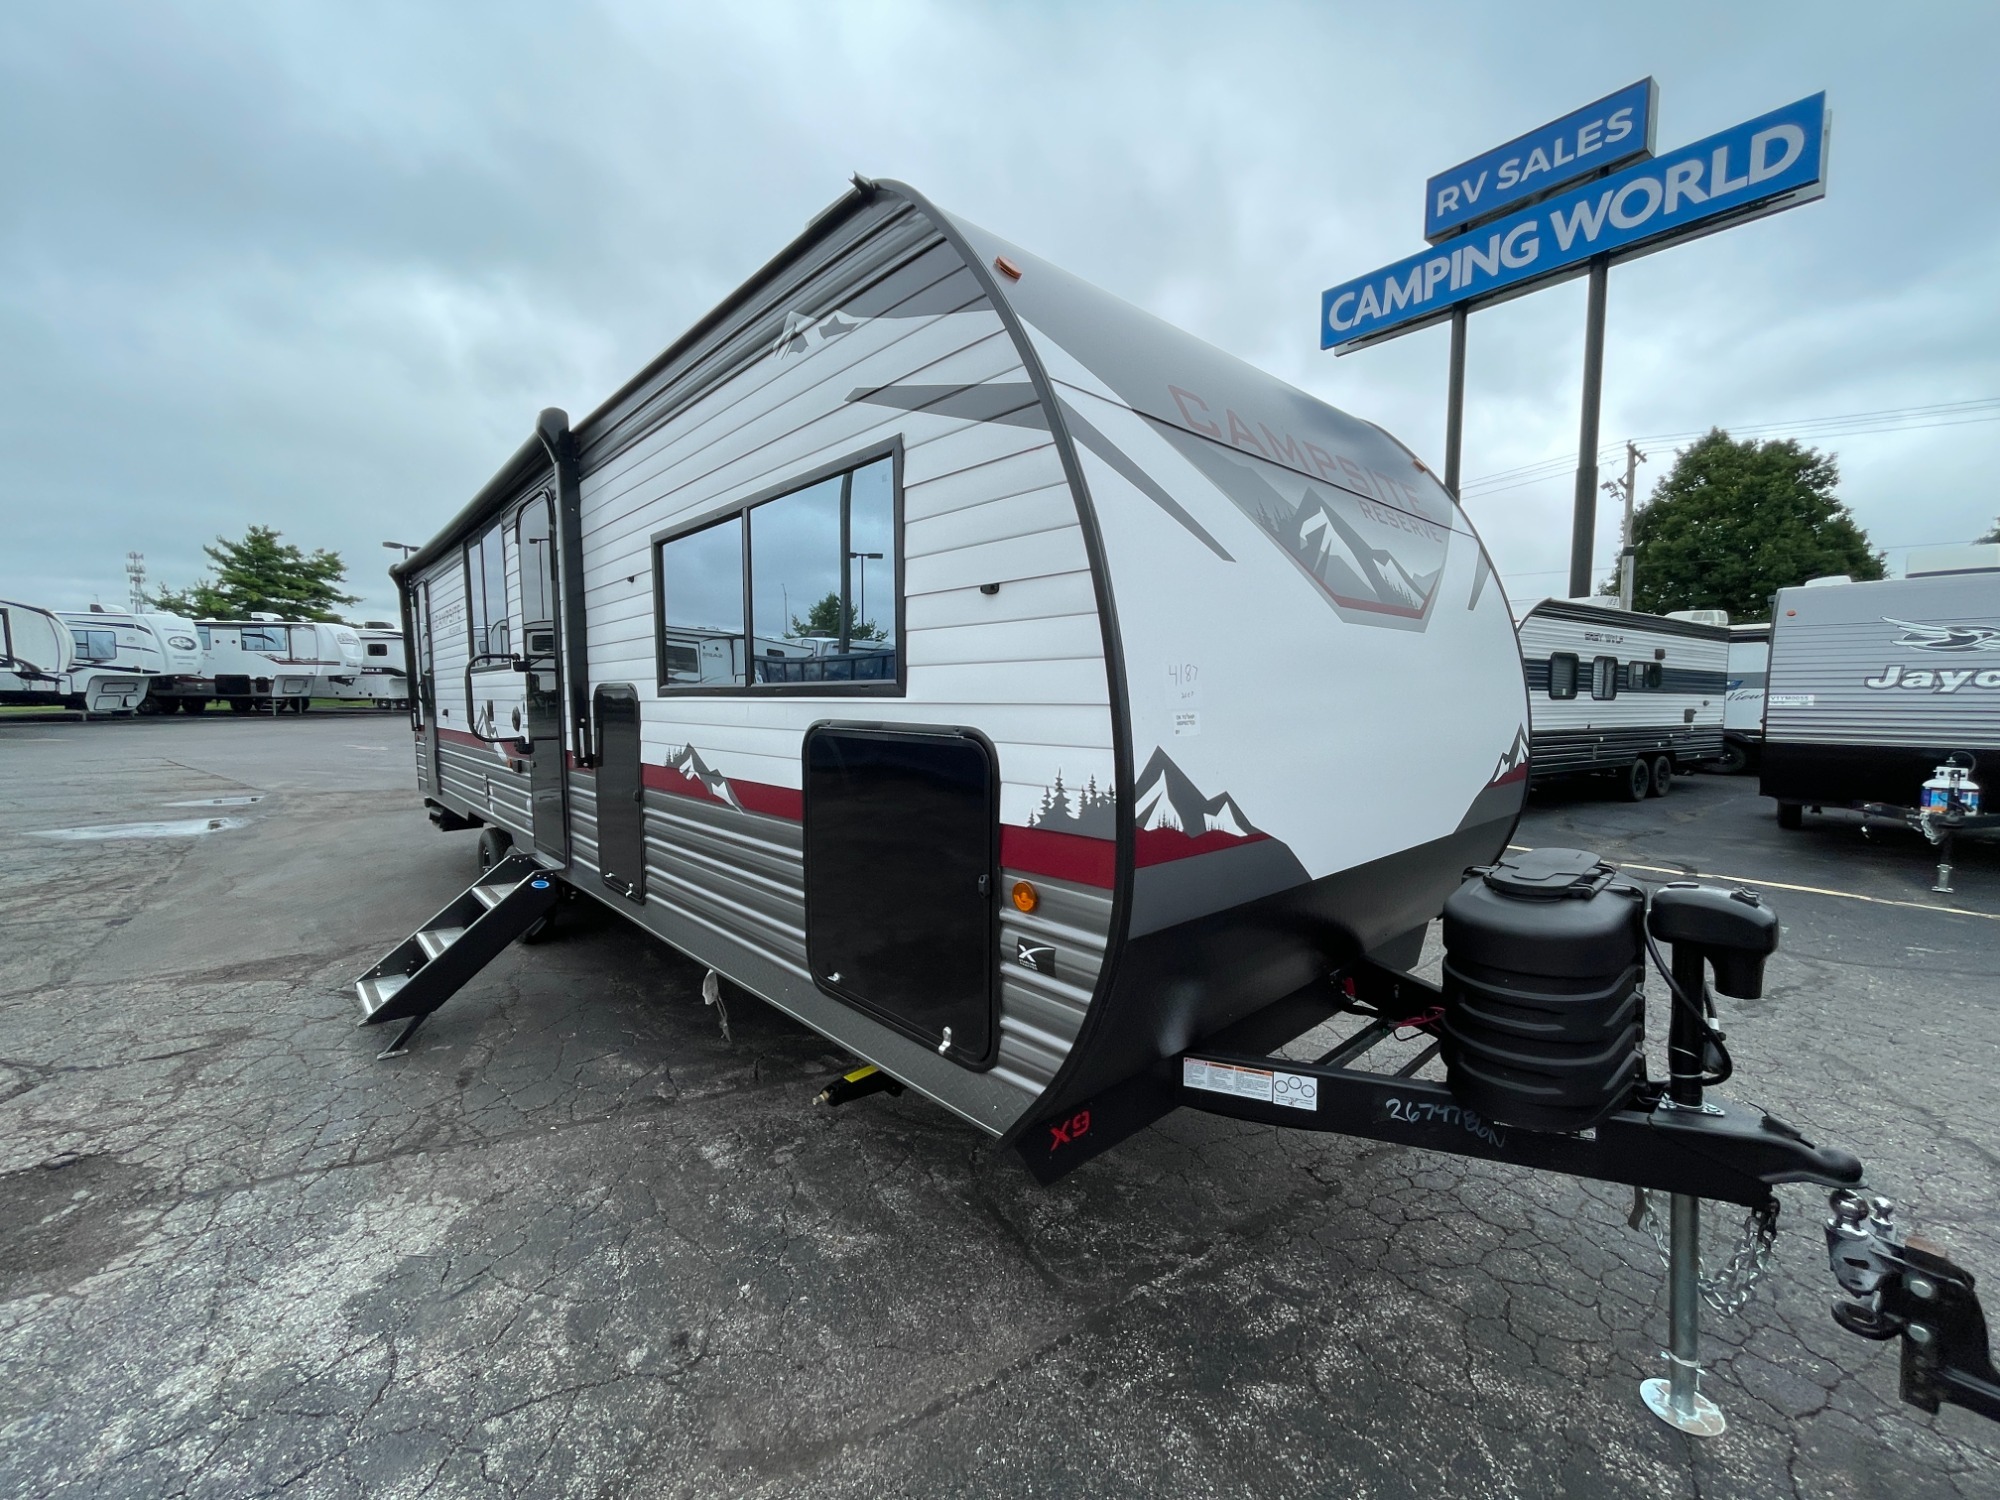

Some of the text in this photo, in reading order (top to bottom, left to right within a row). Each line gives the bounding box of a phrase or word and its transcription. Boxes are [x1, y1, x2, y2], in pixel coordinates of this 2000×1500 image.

[1436, 107, 1634, 218] RV SALES
[1328, 123, 1805, 332] CAMPING WORLD
[1167, 384, 1431, 519] CAMPSITE
[1362, 500, 1443, 544] RESERVE
[1168, 663, 1198, 687] 4187
[1727, 689, 1764, 701] View
